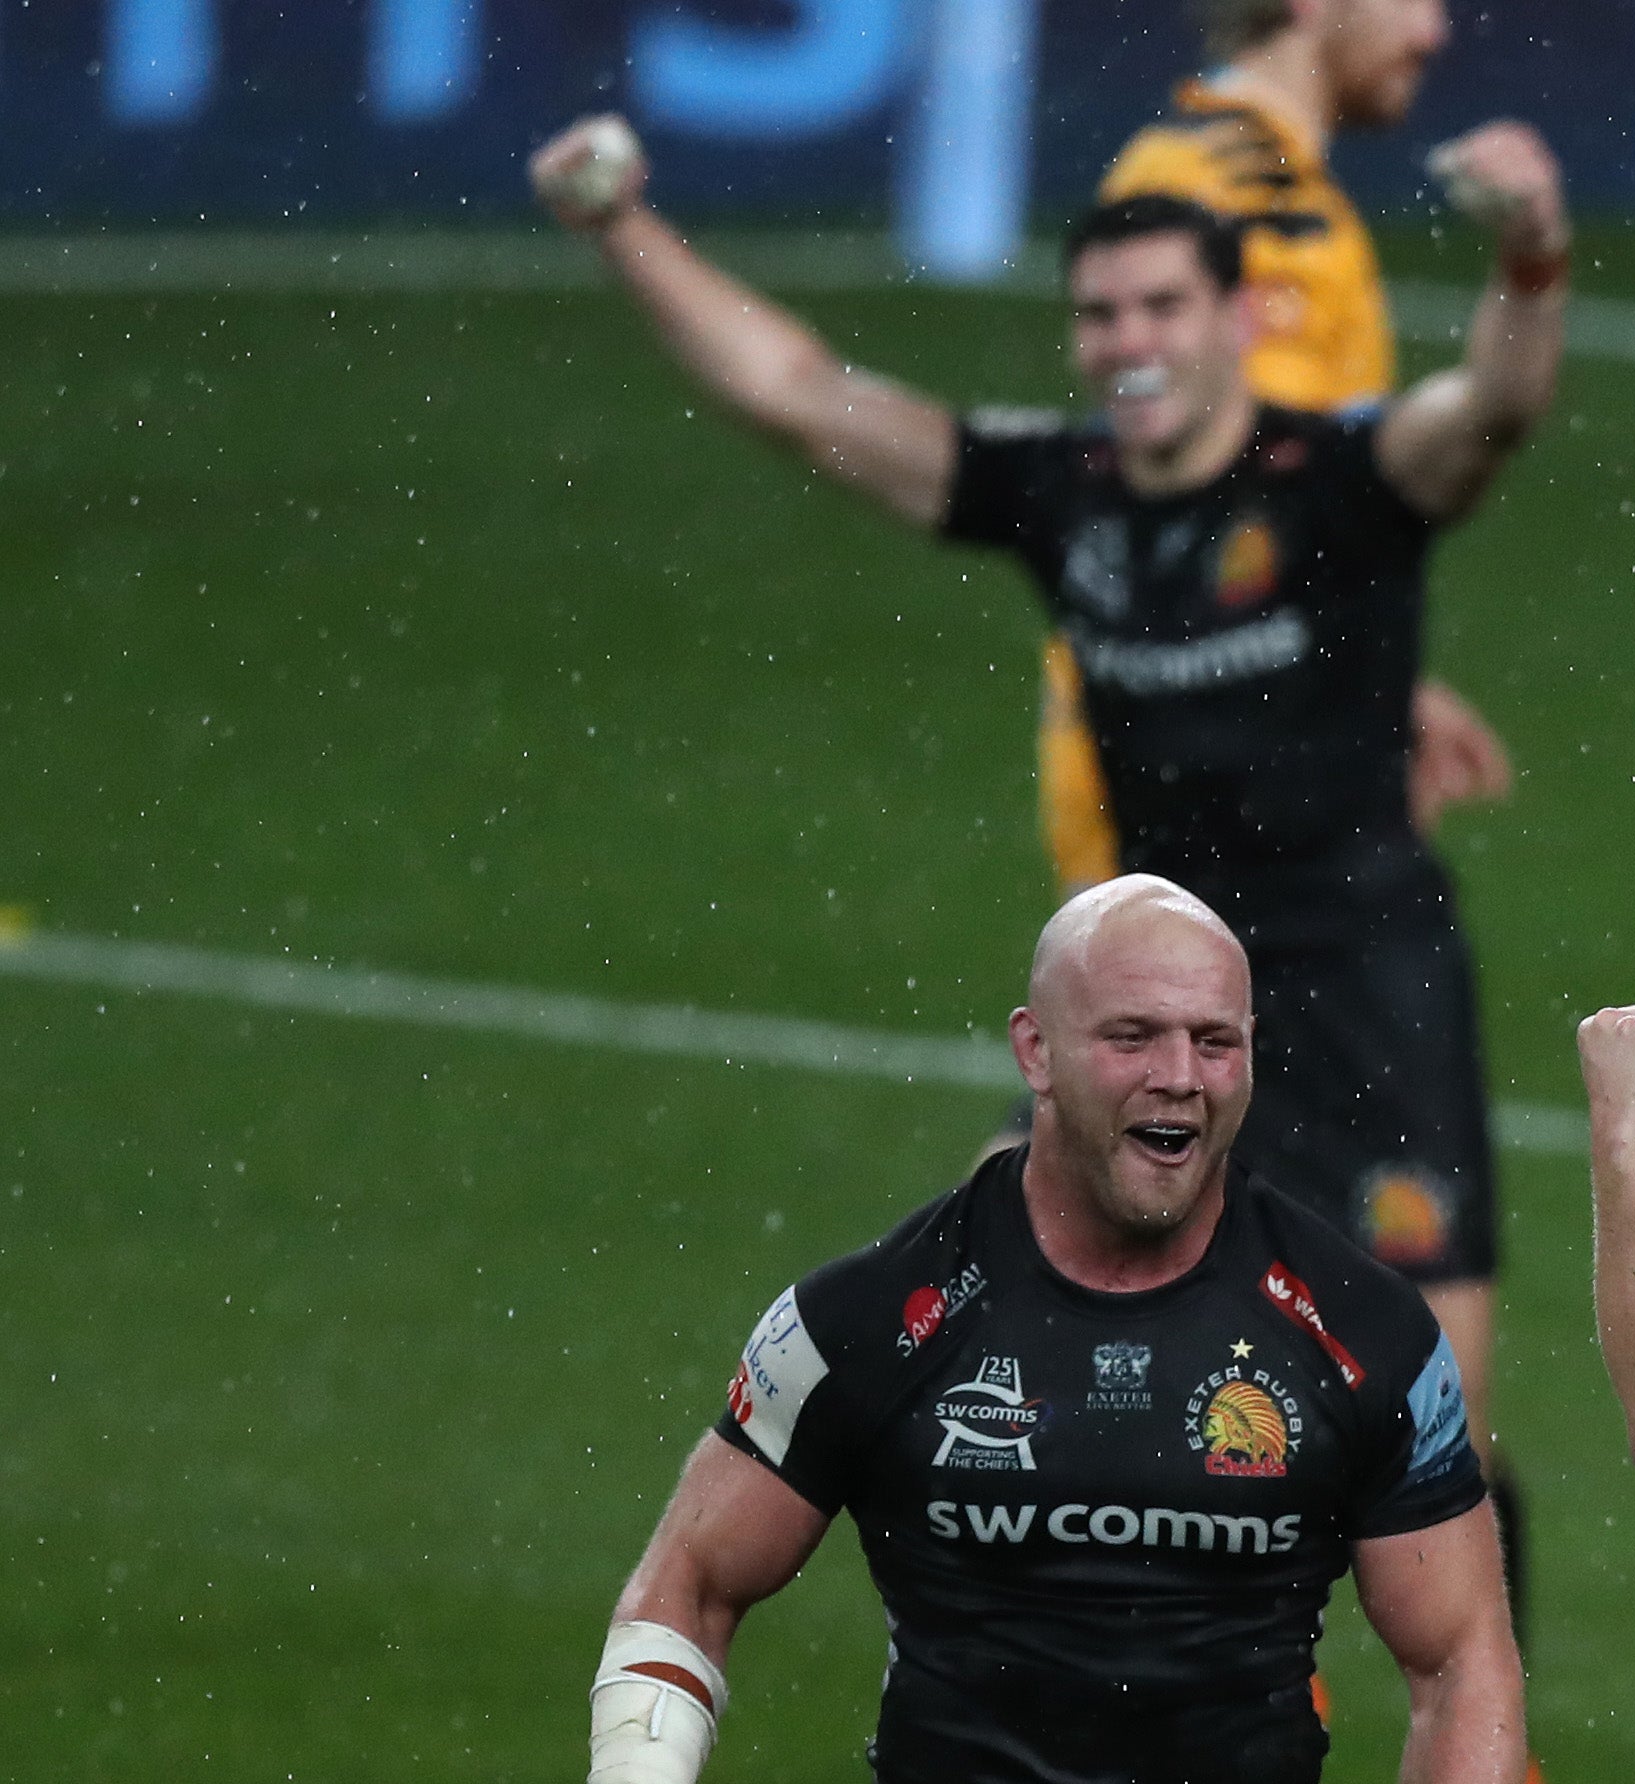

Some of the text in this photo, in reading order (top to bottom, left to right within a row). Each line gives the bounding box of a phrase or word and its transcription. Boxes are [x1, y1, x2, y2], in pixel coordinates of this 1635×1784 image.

[1295, 1296, 1356, 1384] WAN
[987, 1356, 1013, 1376] 25
[1087, 1392, 1152, 1402] EXETER
[1184, 1366, 1303, 1452] EXETER RUGBY
[951, 1448, 1017, 1460] SUPPORTING
[948, 1457, 1019, 1471] THE CHIEFS
